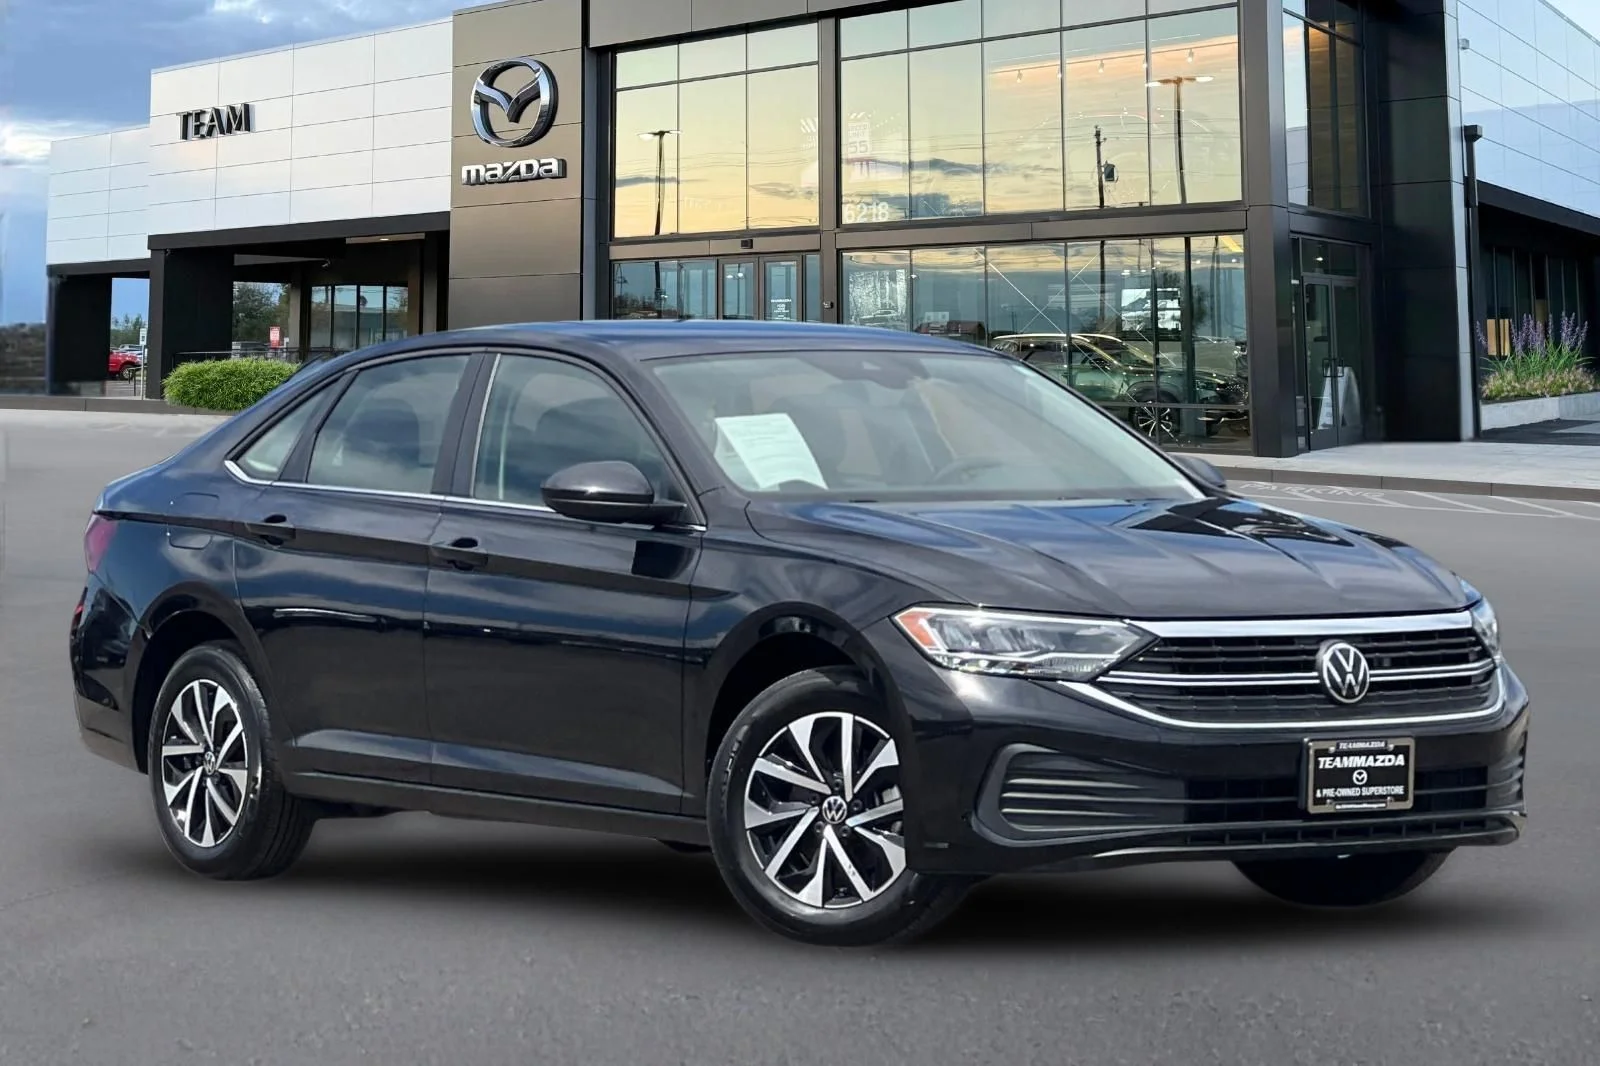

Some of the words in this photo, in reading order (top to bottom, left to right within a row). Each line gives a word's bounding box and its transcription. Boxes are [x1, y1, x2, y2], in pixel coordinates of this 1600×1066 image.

[176, 103, 251, 140] TEAM
[461, 157, 566, 186] mazda
[845, 201, 890, 222] 6218
[1239, 482, 1385, 498] PARKING
[1318, 754, 1405, 769] TEAMMAZDA
[1322, 786, 1361, 798] PRE-OWNED
[1361, 785, 1405, 797] SUPERSTORE
